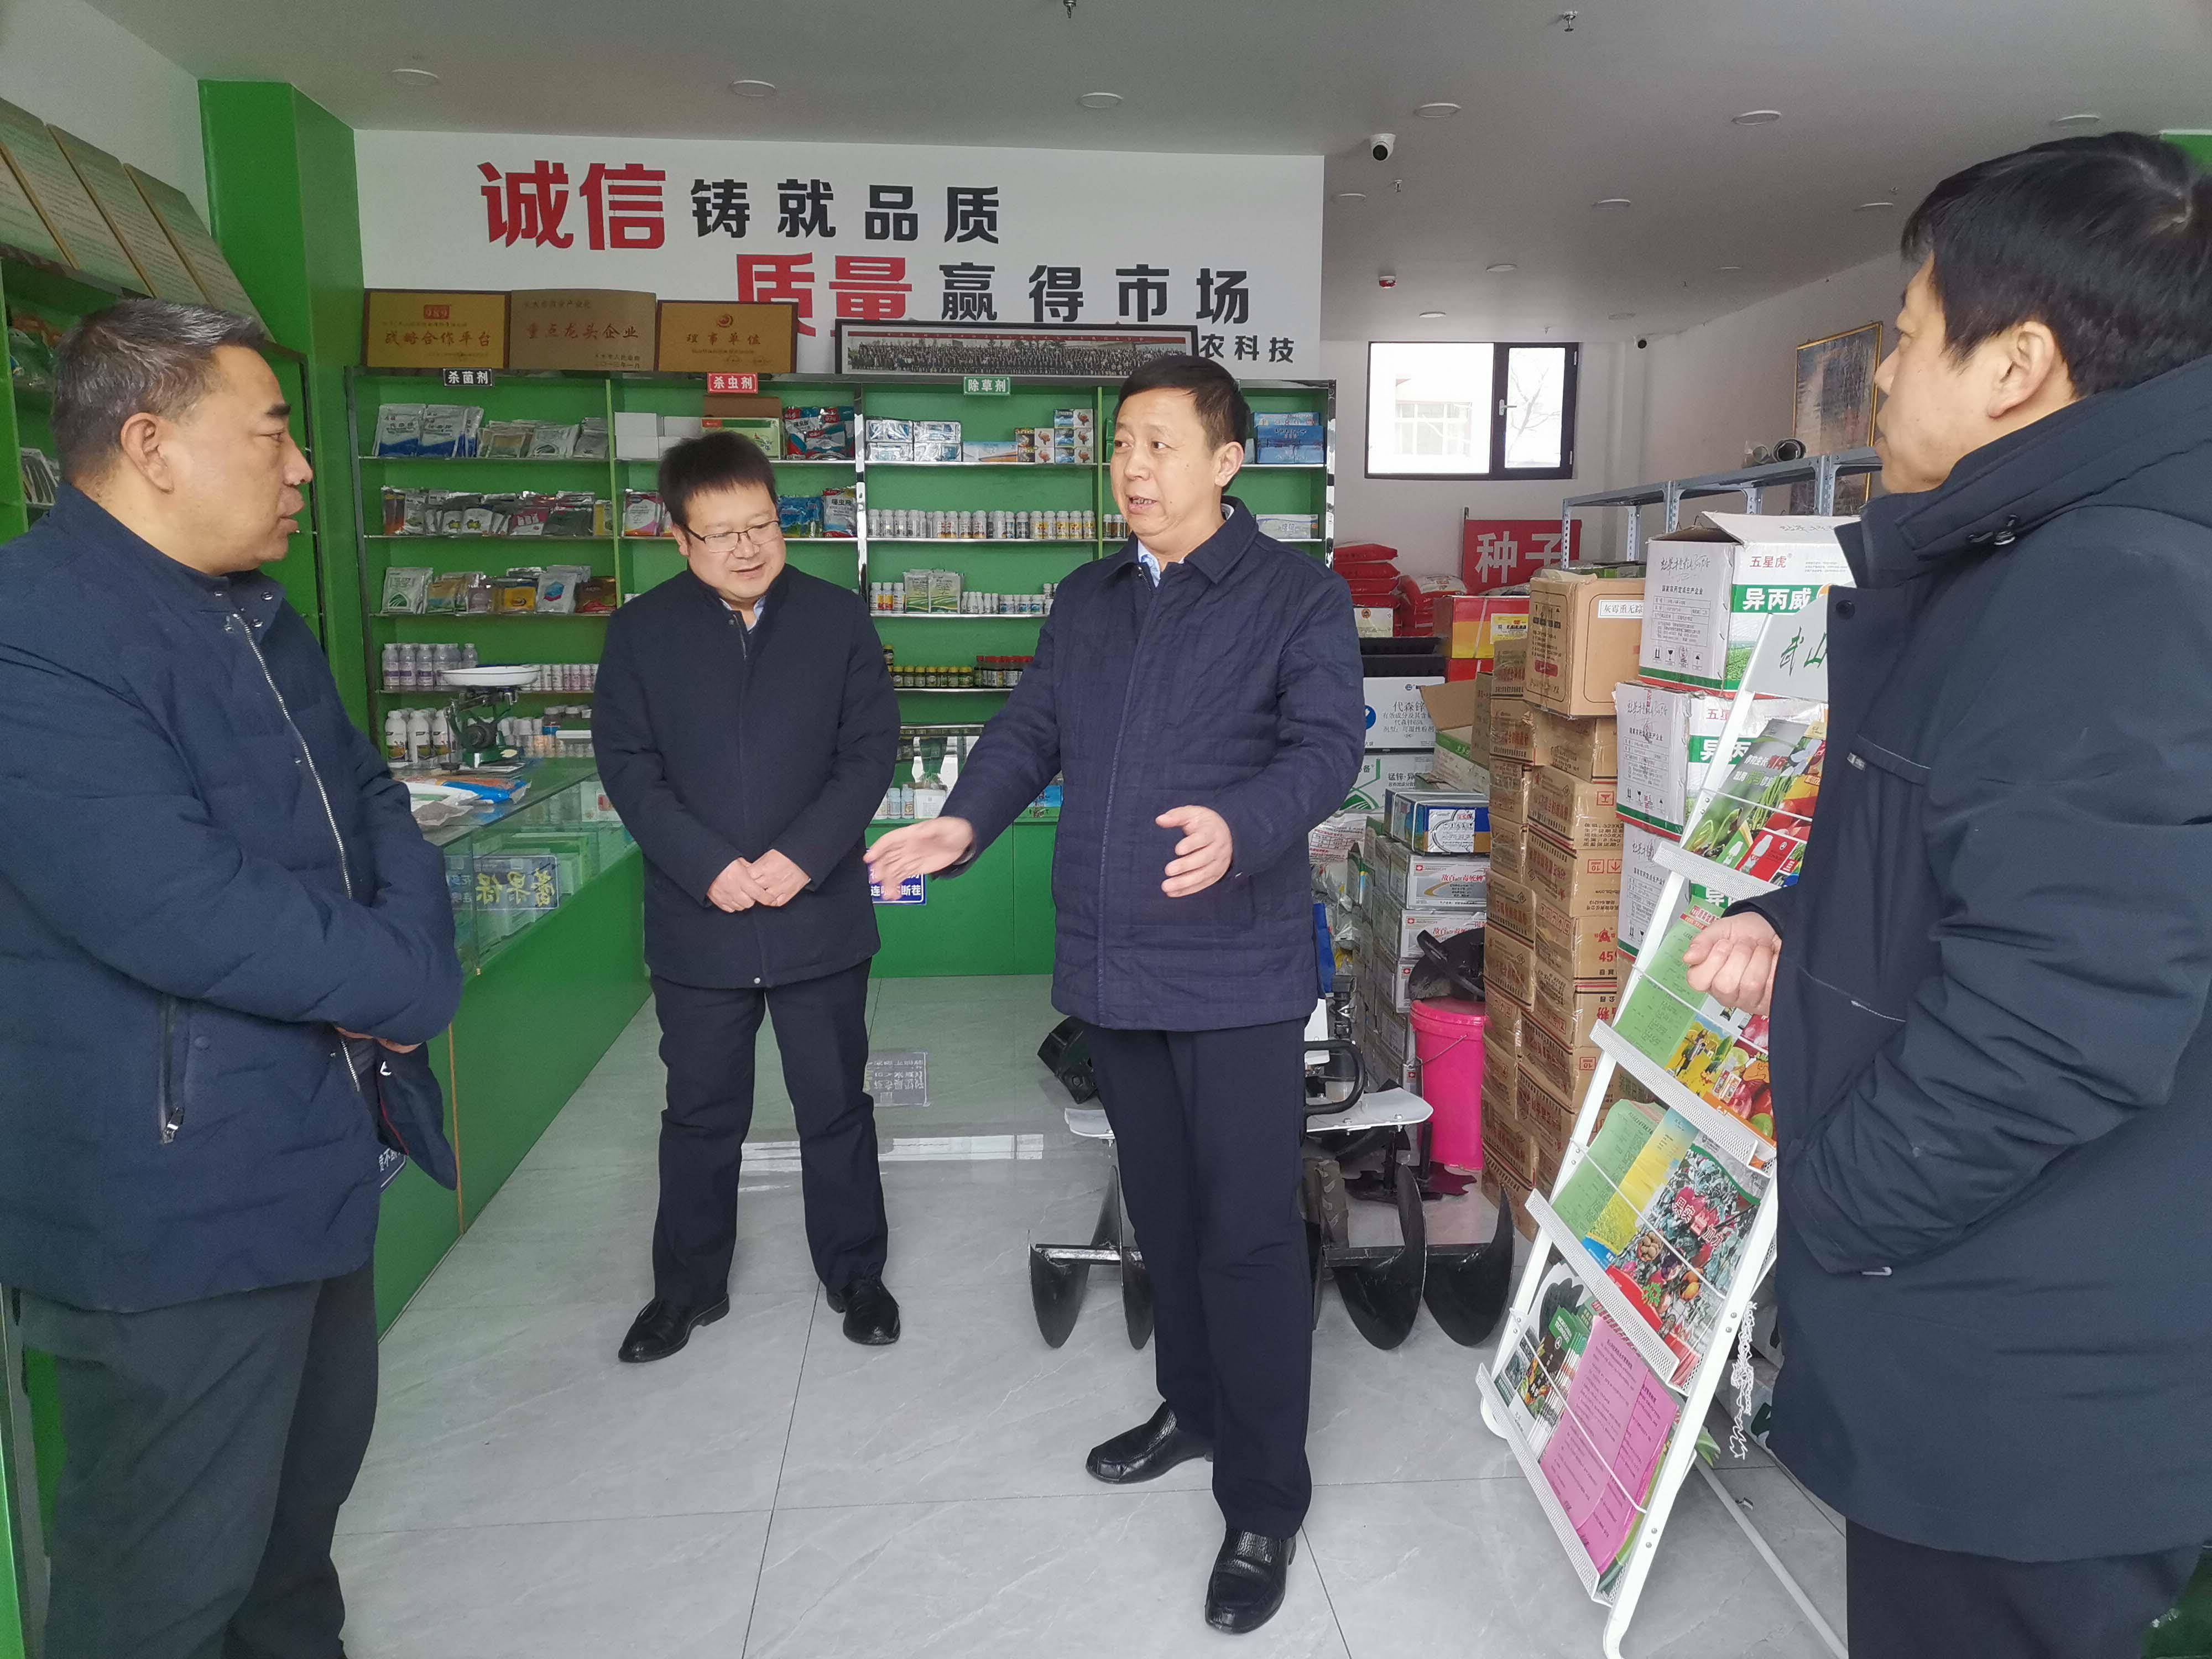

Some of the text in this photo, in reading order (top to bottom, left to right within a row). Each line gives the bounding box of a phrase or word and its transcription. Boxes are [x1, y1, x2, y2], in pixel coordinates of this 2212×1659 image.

[735, 253, 1250, 337] 质量赢得市场
[526, 322, 639, 340] 重点龙头企业
[1199, 333, 1294, 363] 农科技
[447, 371, 489, 384] 杀菌剂
[713, 375, 753, 389] 杀虫剂
[968, 379, 1006, 393] 除草剂
[1475, 530, 1562, 584] 种子
[1750, 556, 1787, 568] 五星虎
[1743, 588, 1811, 611] 异丙威
[870, 884, 921, 896] 连断茬
[1598, 951, 1618, 963] 45
